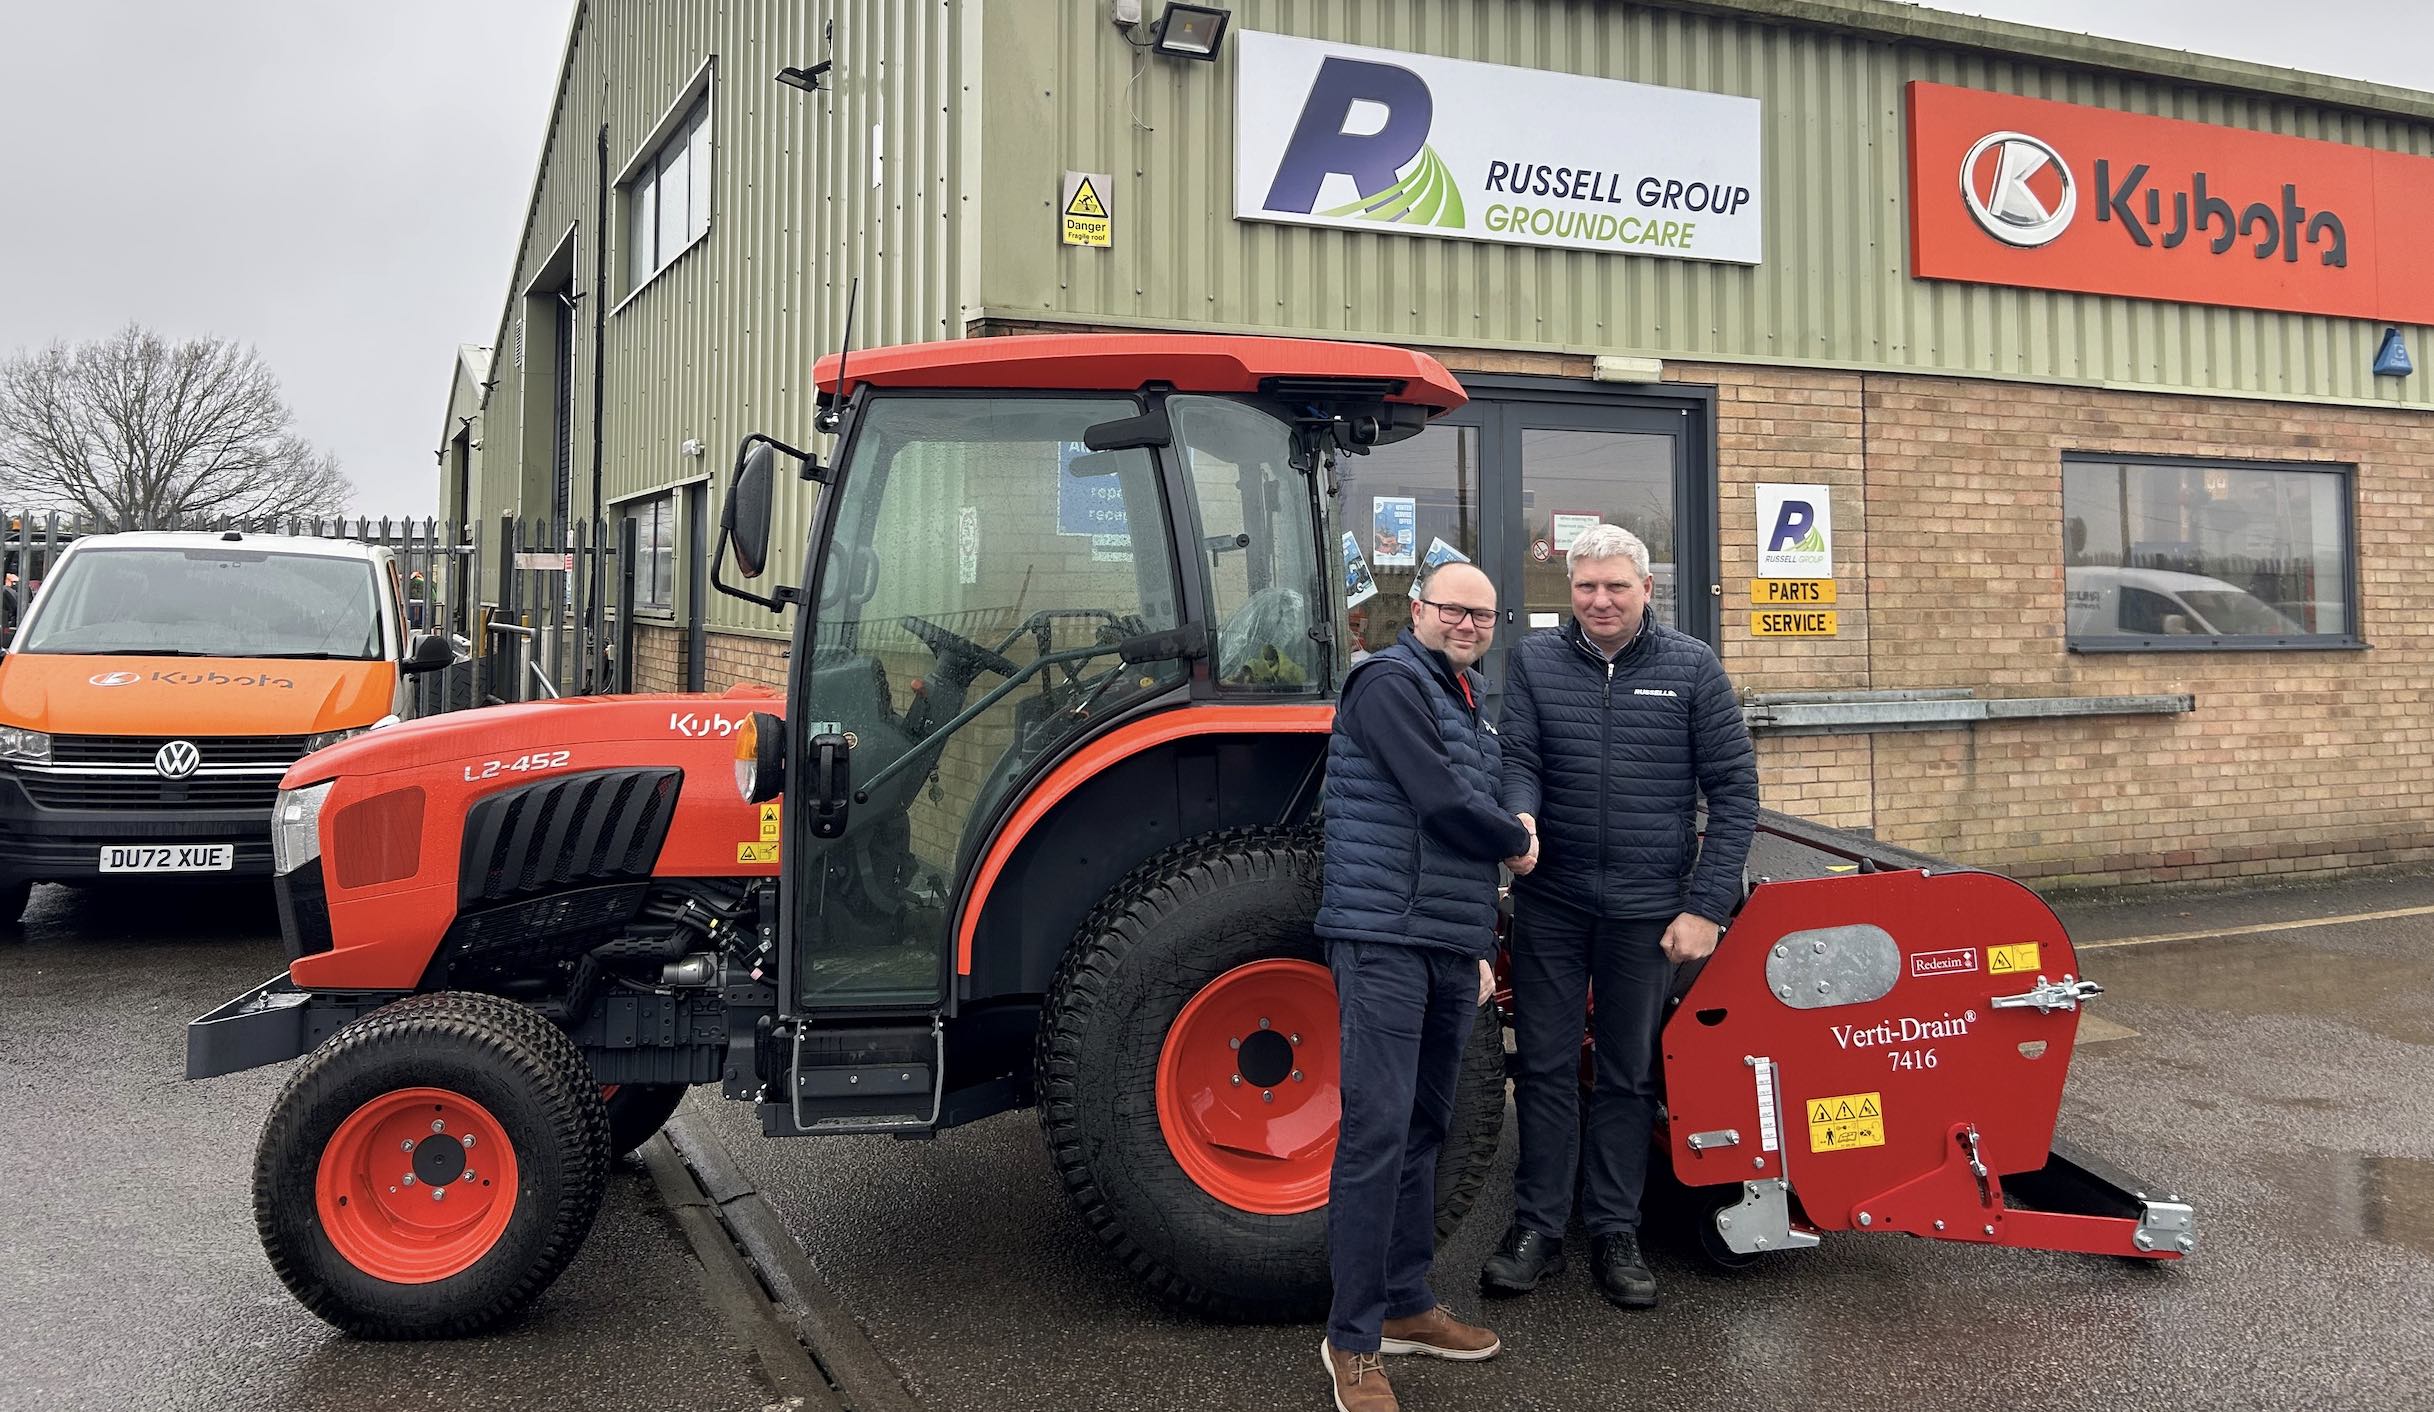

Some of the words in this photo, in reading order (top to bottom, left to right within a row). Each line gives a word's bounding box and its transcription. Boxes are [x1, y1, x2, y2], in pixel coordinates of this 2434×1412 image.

[1485, 160, 1622, 204] RUSSELL
[1636, 176, 1750, 215] GROUP
[2095, 158, 2348, 268] Kubota
[1067, 219, 1106, 233] Danger
[1484, 204, 1696, 249] GROUNDCARE
[1068, 231, 1090, 241] Fragile
[1765, 555, 1797, 563] RUSSELL
[1798, 555, 1824, 564] GROUP
[1769, 582, 1819, 600] PARTS
[1762, 614, 1826, 632] SERVICE
[152, 672, 294, 689] Kubota
[1634, 689, 1669, 697] RUSSELL
[464, 750, 571, 782] L2-452
[110, 849, 171, 868] DU72
[177, 848, 223, 867] XUE
[1916, 958, 1962, 971] Redexim
[1887, 1048, 1938, 1072] 7416
